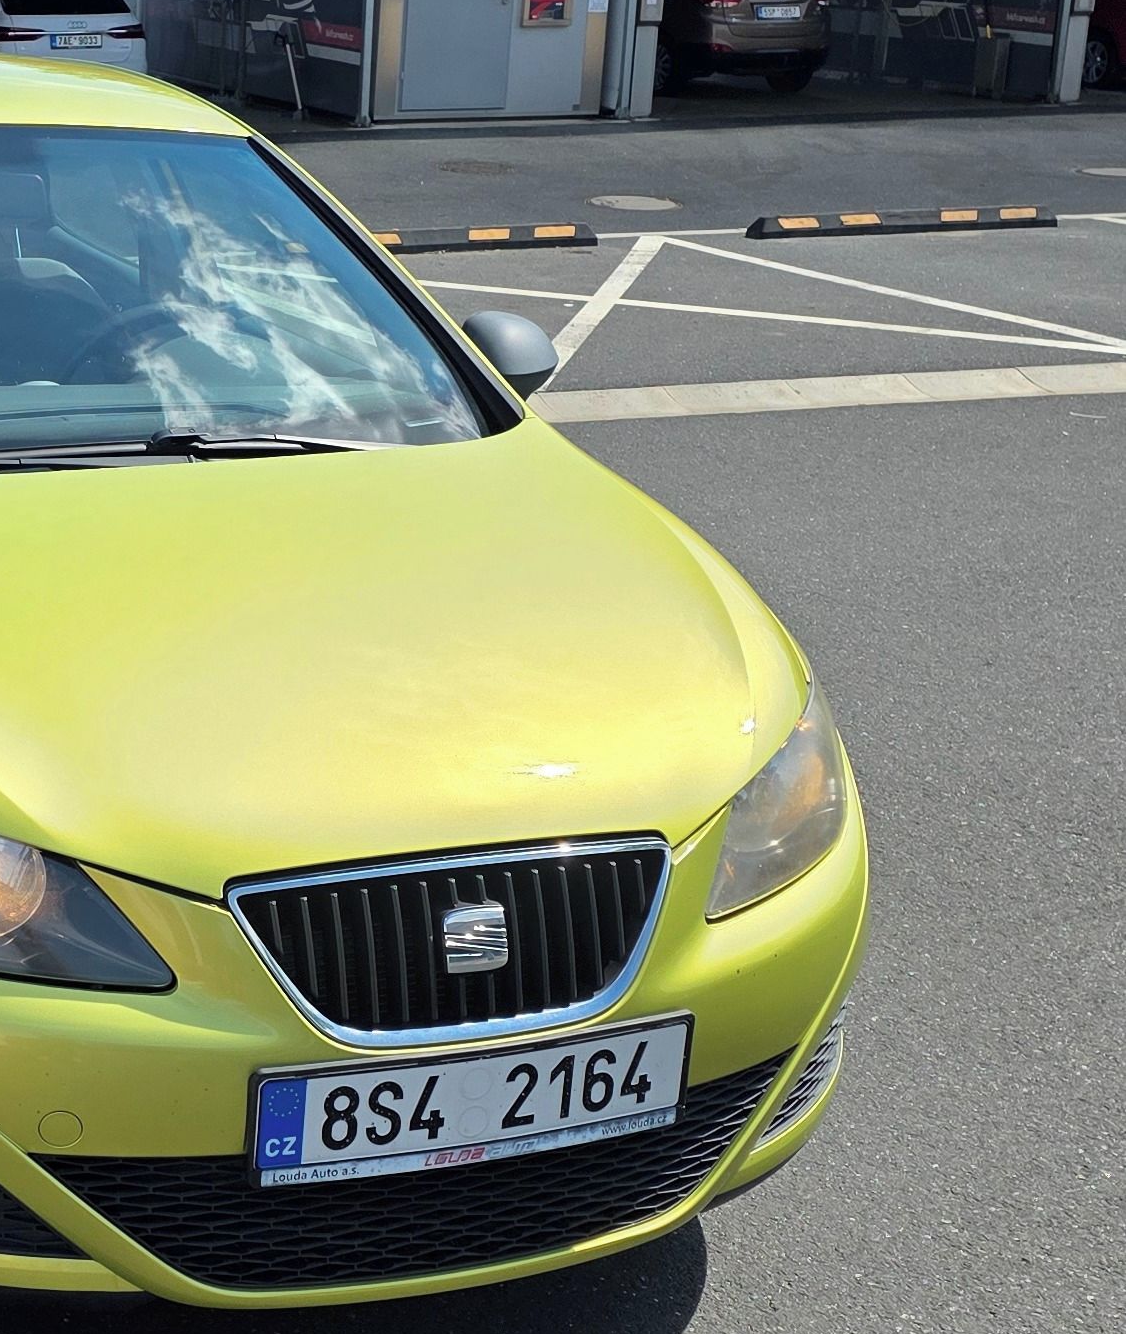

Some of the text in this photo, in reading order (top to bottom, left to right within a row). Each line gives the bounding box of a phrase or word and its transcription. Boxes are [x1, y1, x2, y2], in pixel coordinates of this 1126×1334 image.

[59, 35, 74, 45] 7AE
[321, 1040, 652, 1151] 8S4 2164
[601, 1114, 668, 1135] www.louda.cz
[265, 1135, 296, 1157] CZ
[272, 1166, 360, 1183] Louda Auto a.s.
